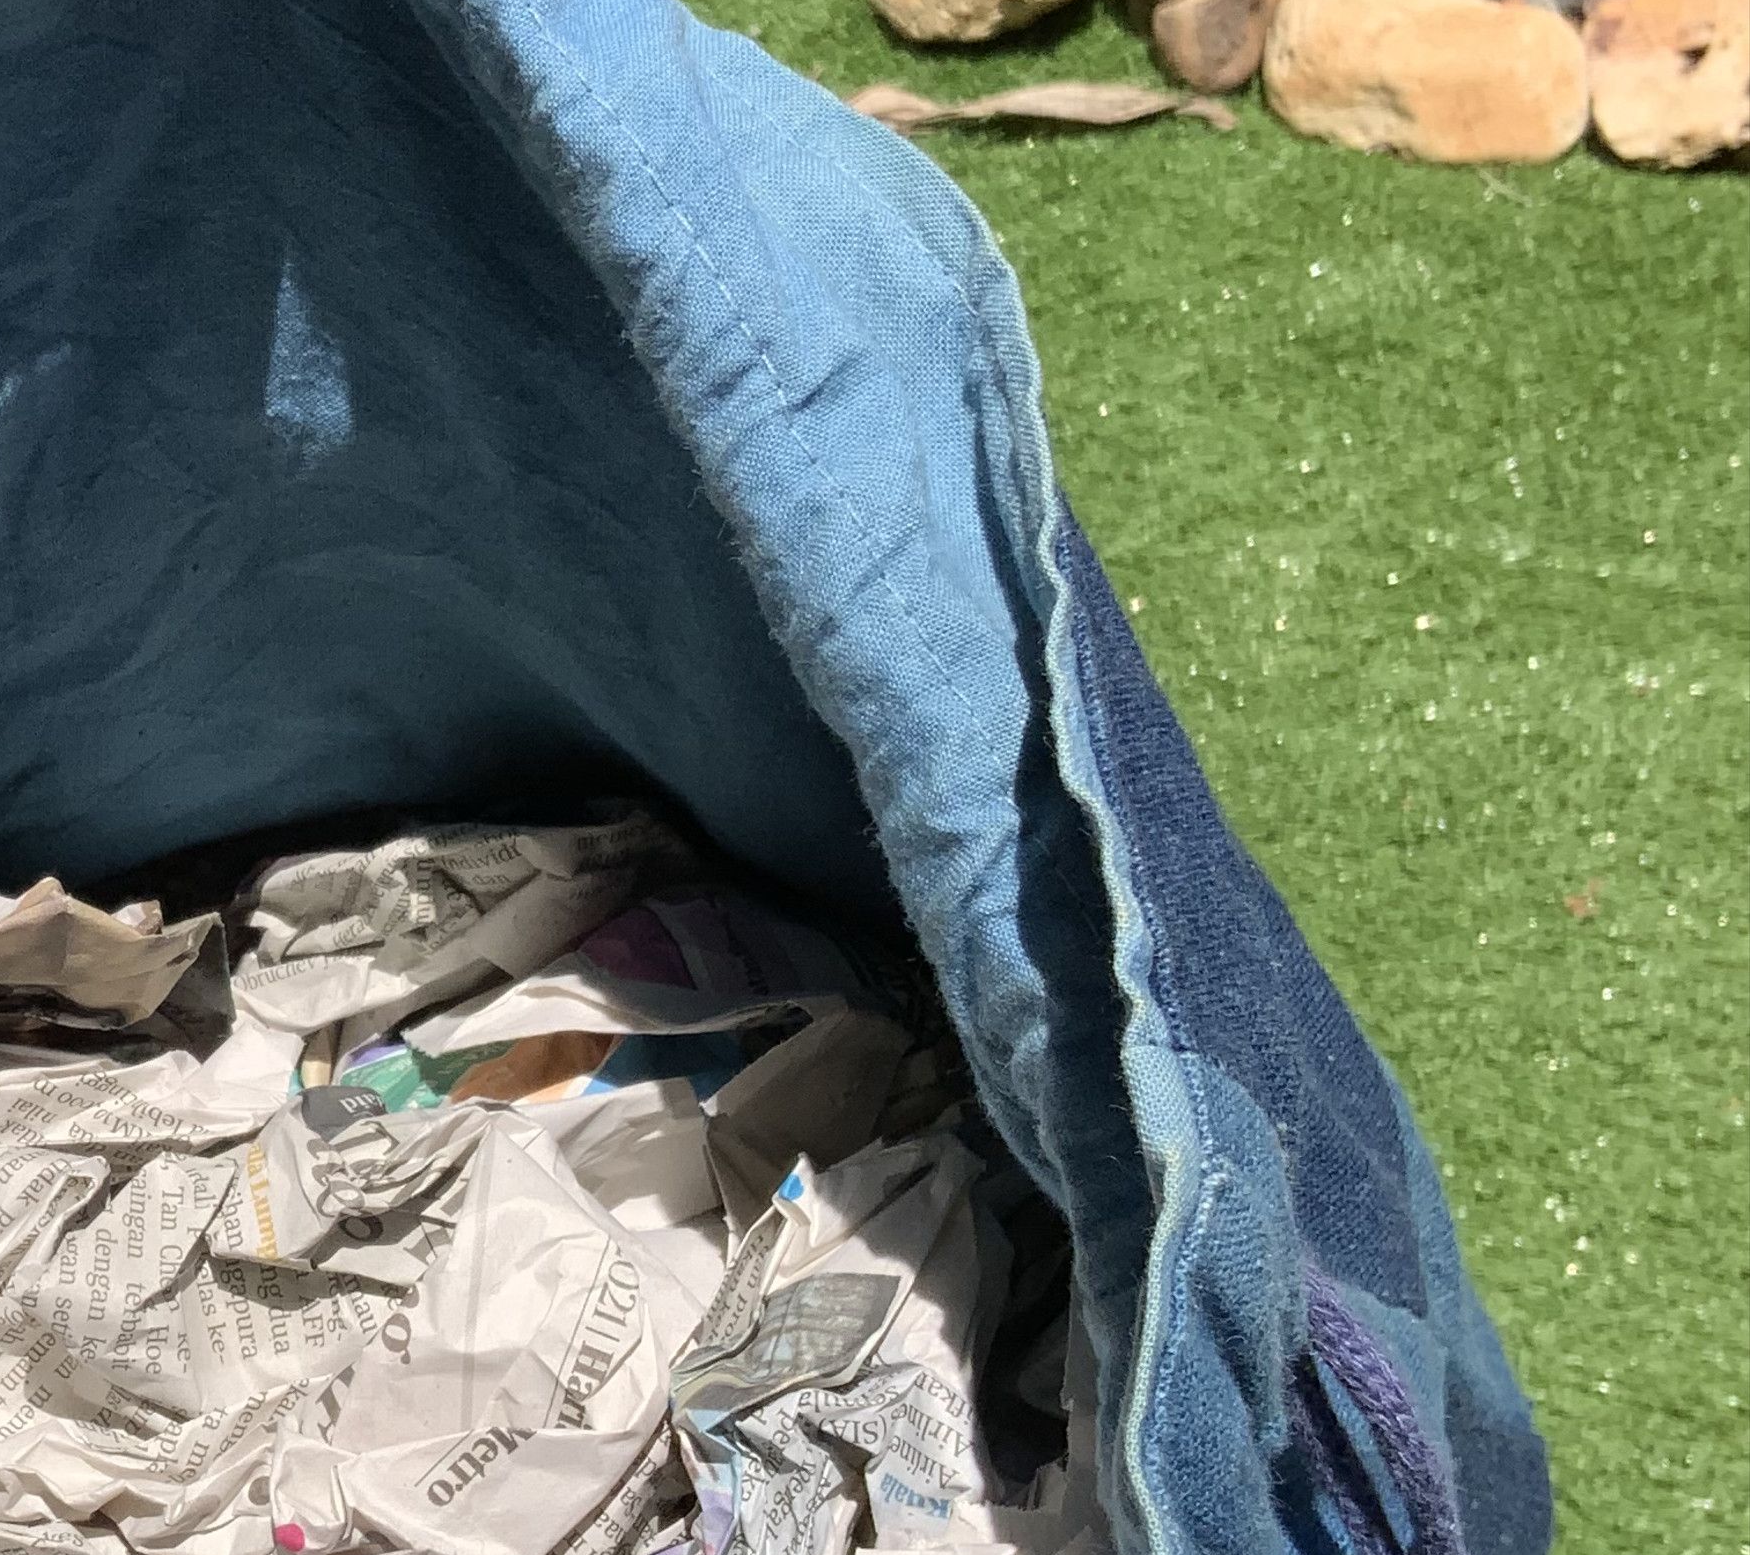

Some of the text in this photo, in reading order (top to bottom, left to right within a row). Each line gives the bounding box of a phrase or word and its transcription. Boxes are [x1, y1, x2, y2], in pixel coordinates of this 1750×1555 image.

[159, 1187, 184, 1230] Tan
[80, 1227, 117, 1321] dengan
[145, 1325, 170, 1374] Hoe
[422, 1411, 532, 1518] Metro
